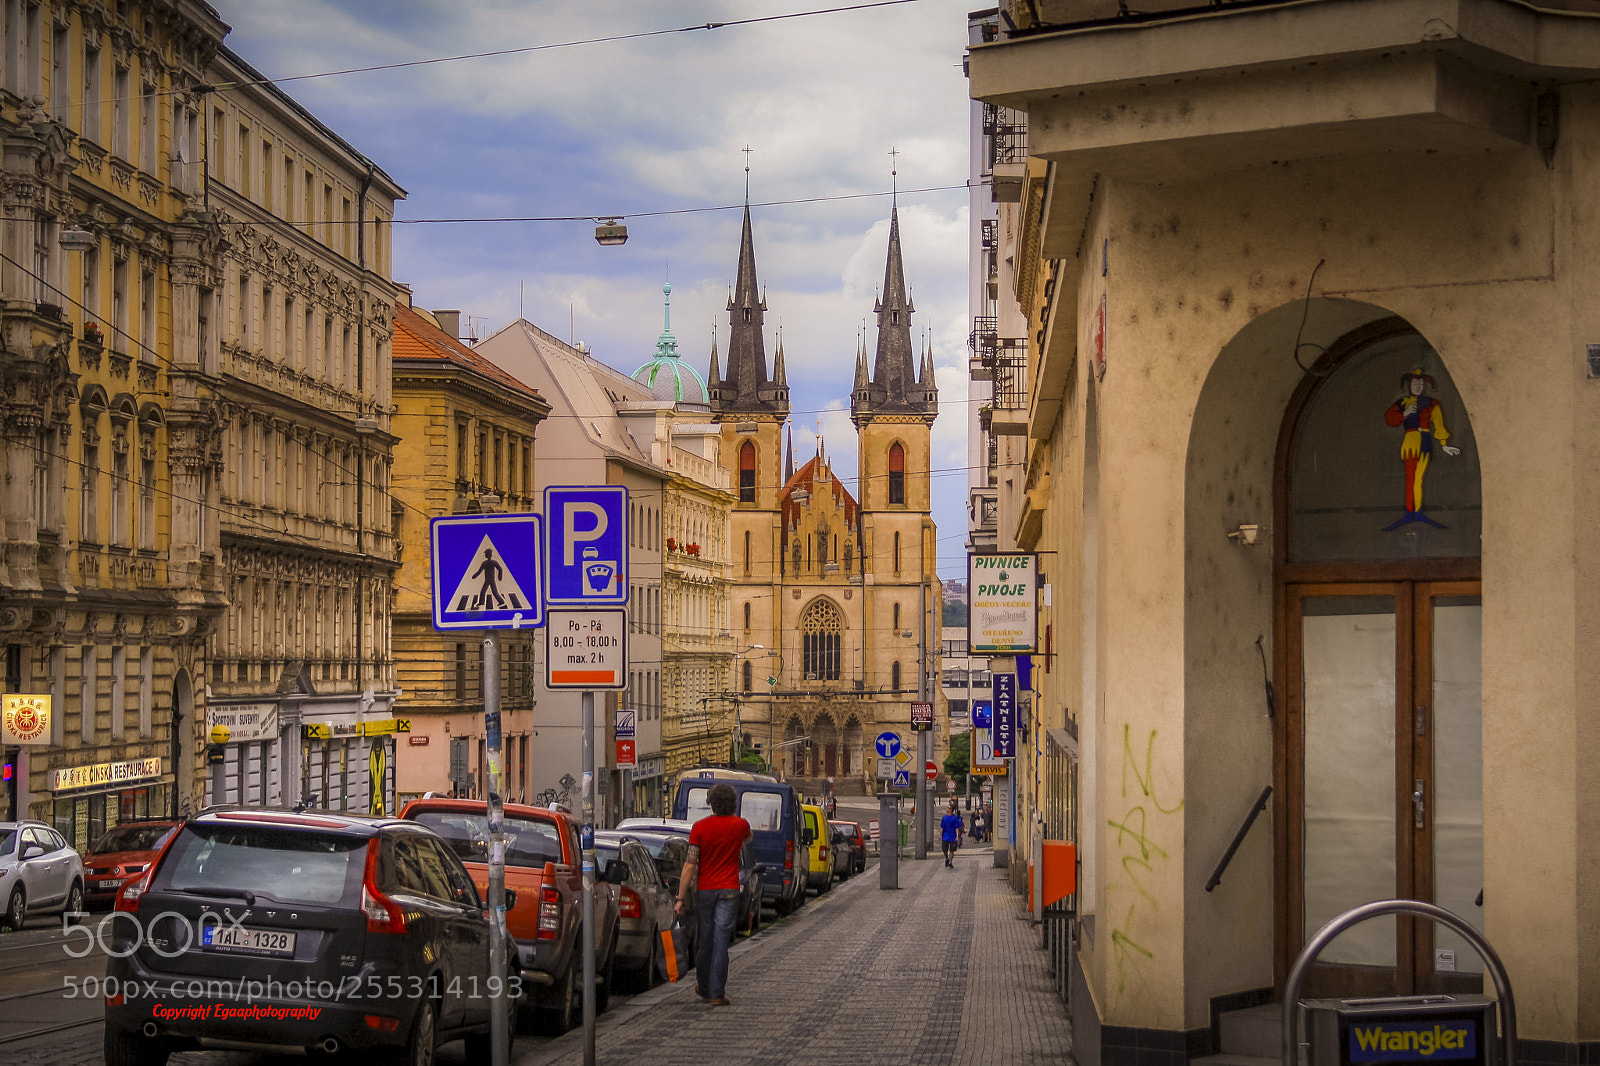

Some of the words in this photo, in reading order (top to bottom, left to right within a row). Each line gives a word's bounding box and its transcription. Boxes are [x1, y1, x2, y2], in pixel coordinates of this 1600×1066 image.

[563, 502, 608, 566] P
[975, 557, 1029, 569] PIVNICE
[978, 584, 1026, 596] PIVOJE
[569, 620, 580, 631] Po
[590, 620, 602, 631] Pá
[611, 636, 618, 648] h
[567, 656, 588, 664] max.
[591, 653, 596, 664] 2
[599, 653, 605, 664] h
[114, 760, 153, 780] RESTAURACE
[217, 930, 241, 946] 1AL
[253, 932, 288, 949] 1328
[1354, 1024, 1468, 1055] Wrangler
